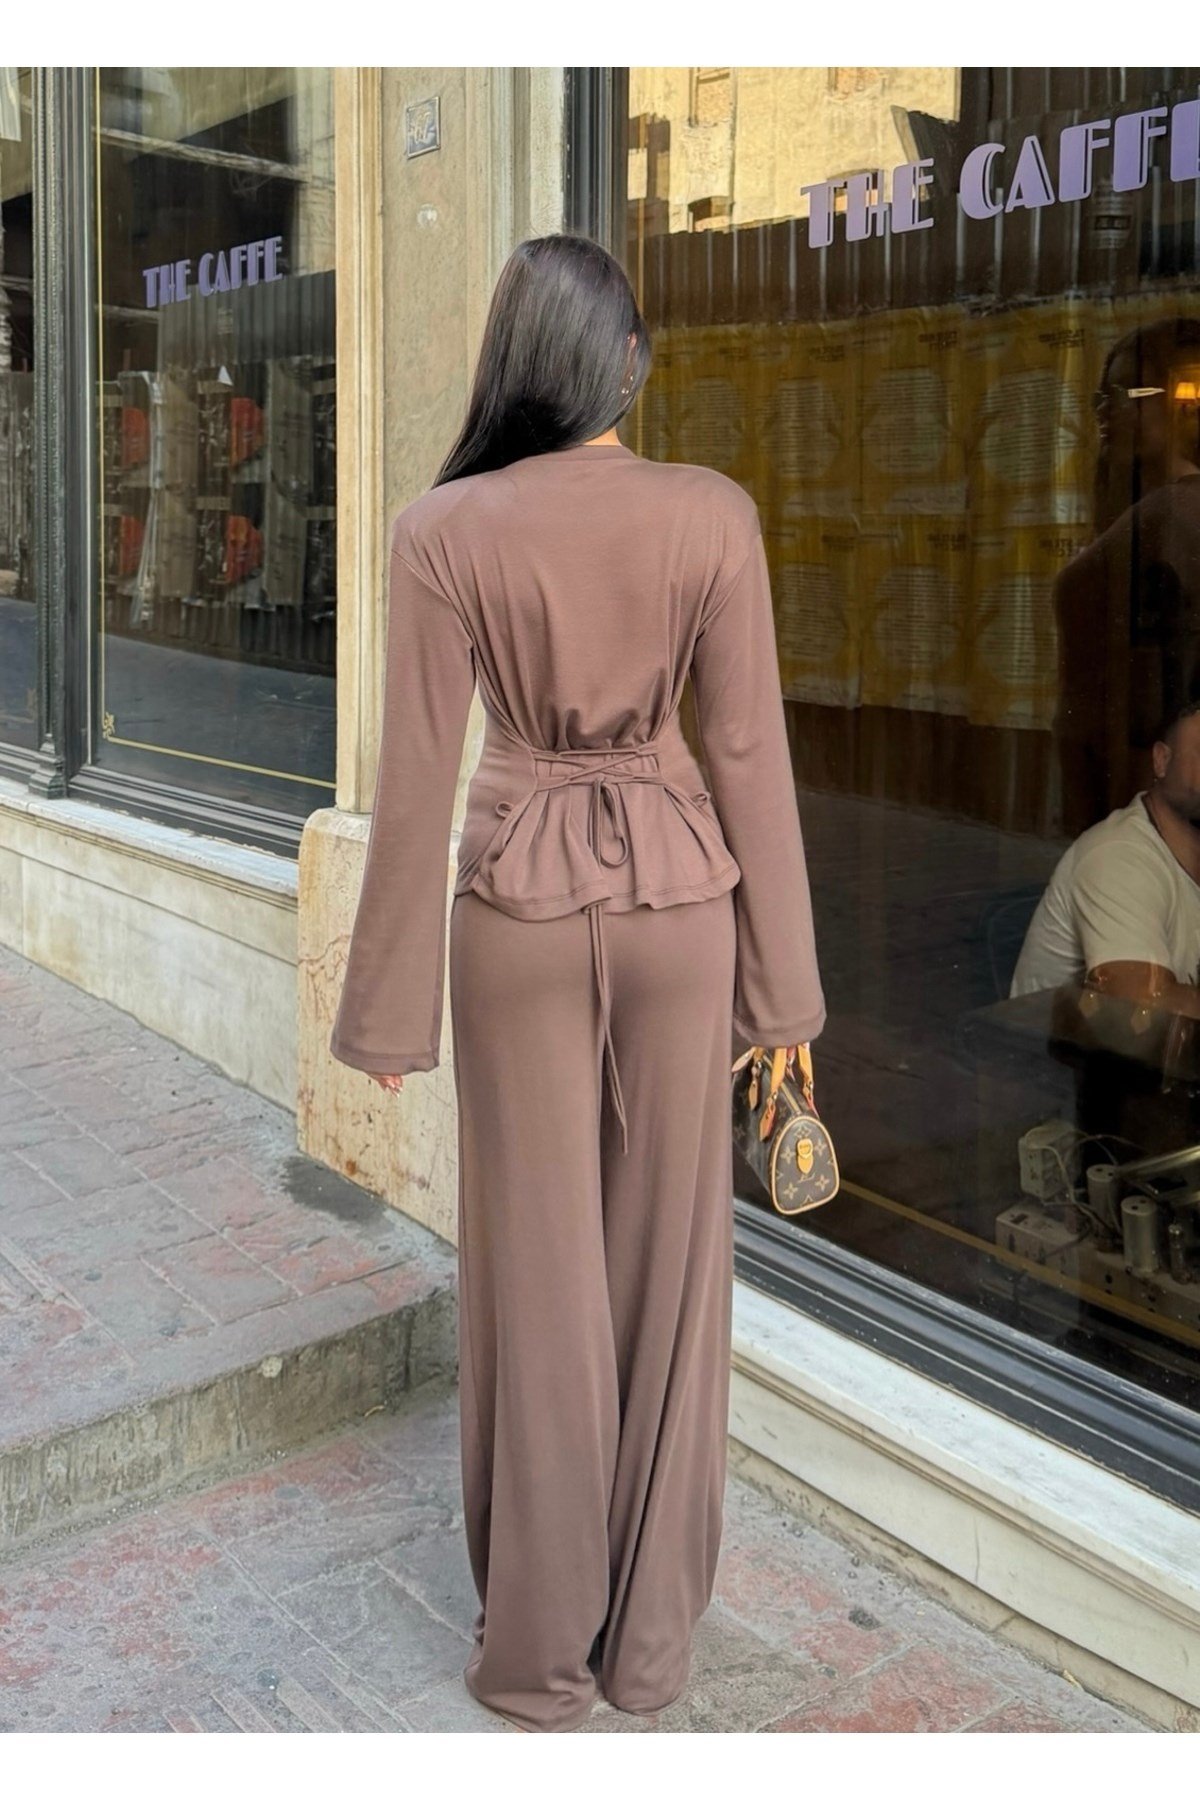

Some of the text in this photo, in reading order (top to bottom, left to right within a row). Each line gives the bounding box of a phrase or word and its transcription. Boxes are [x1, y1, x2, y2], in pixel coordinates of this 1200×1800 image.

[800, 157, 935, 249] THE
[142, 235, 283, 309] THE CAFFE
